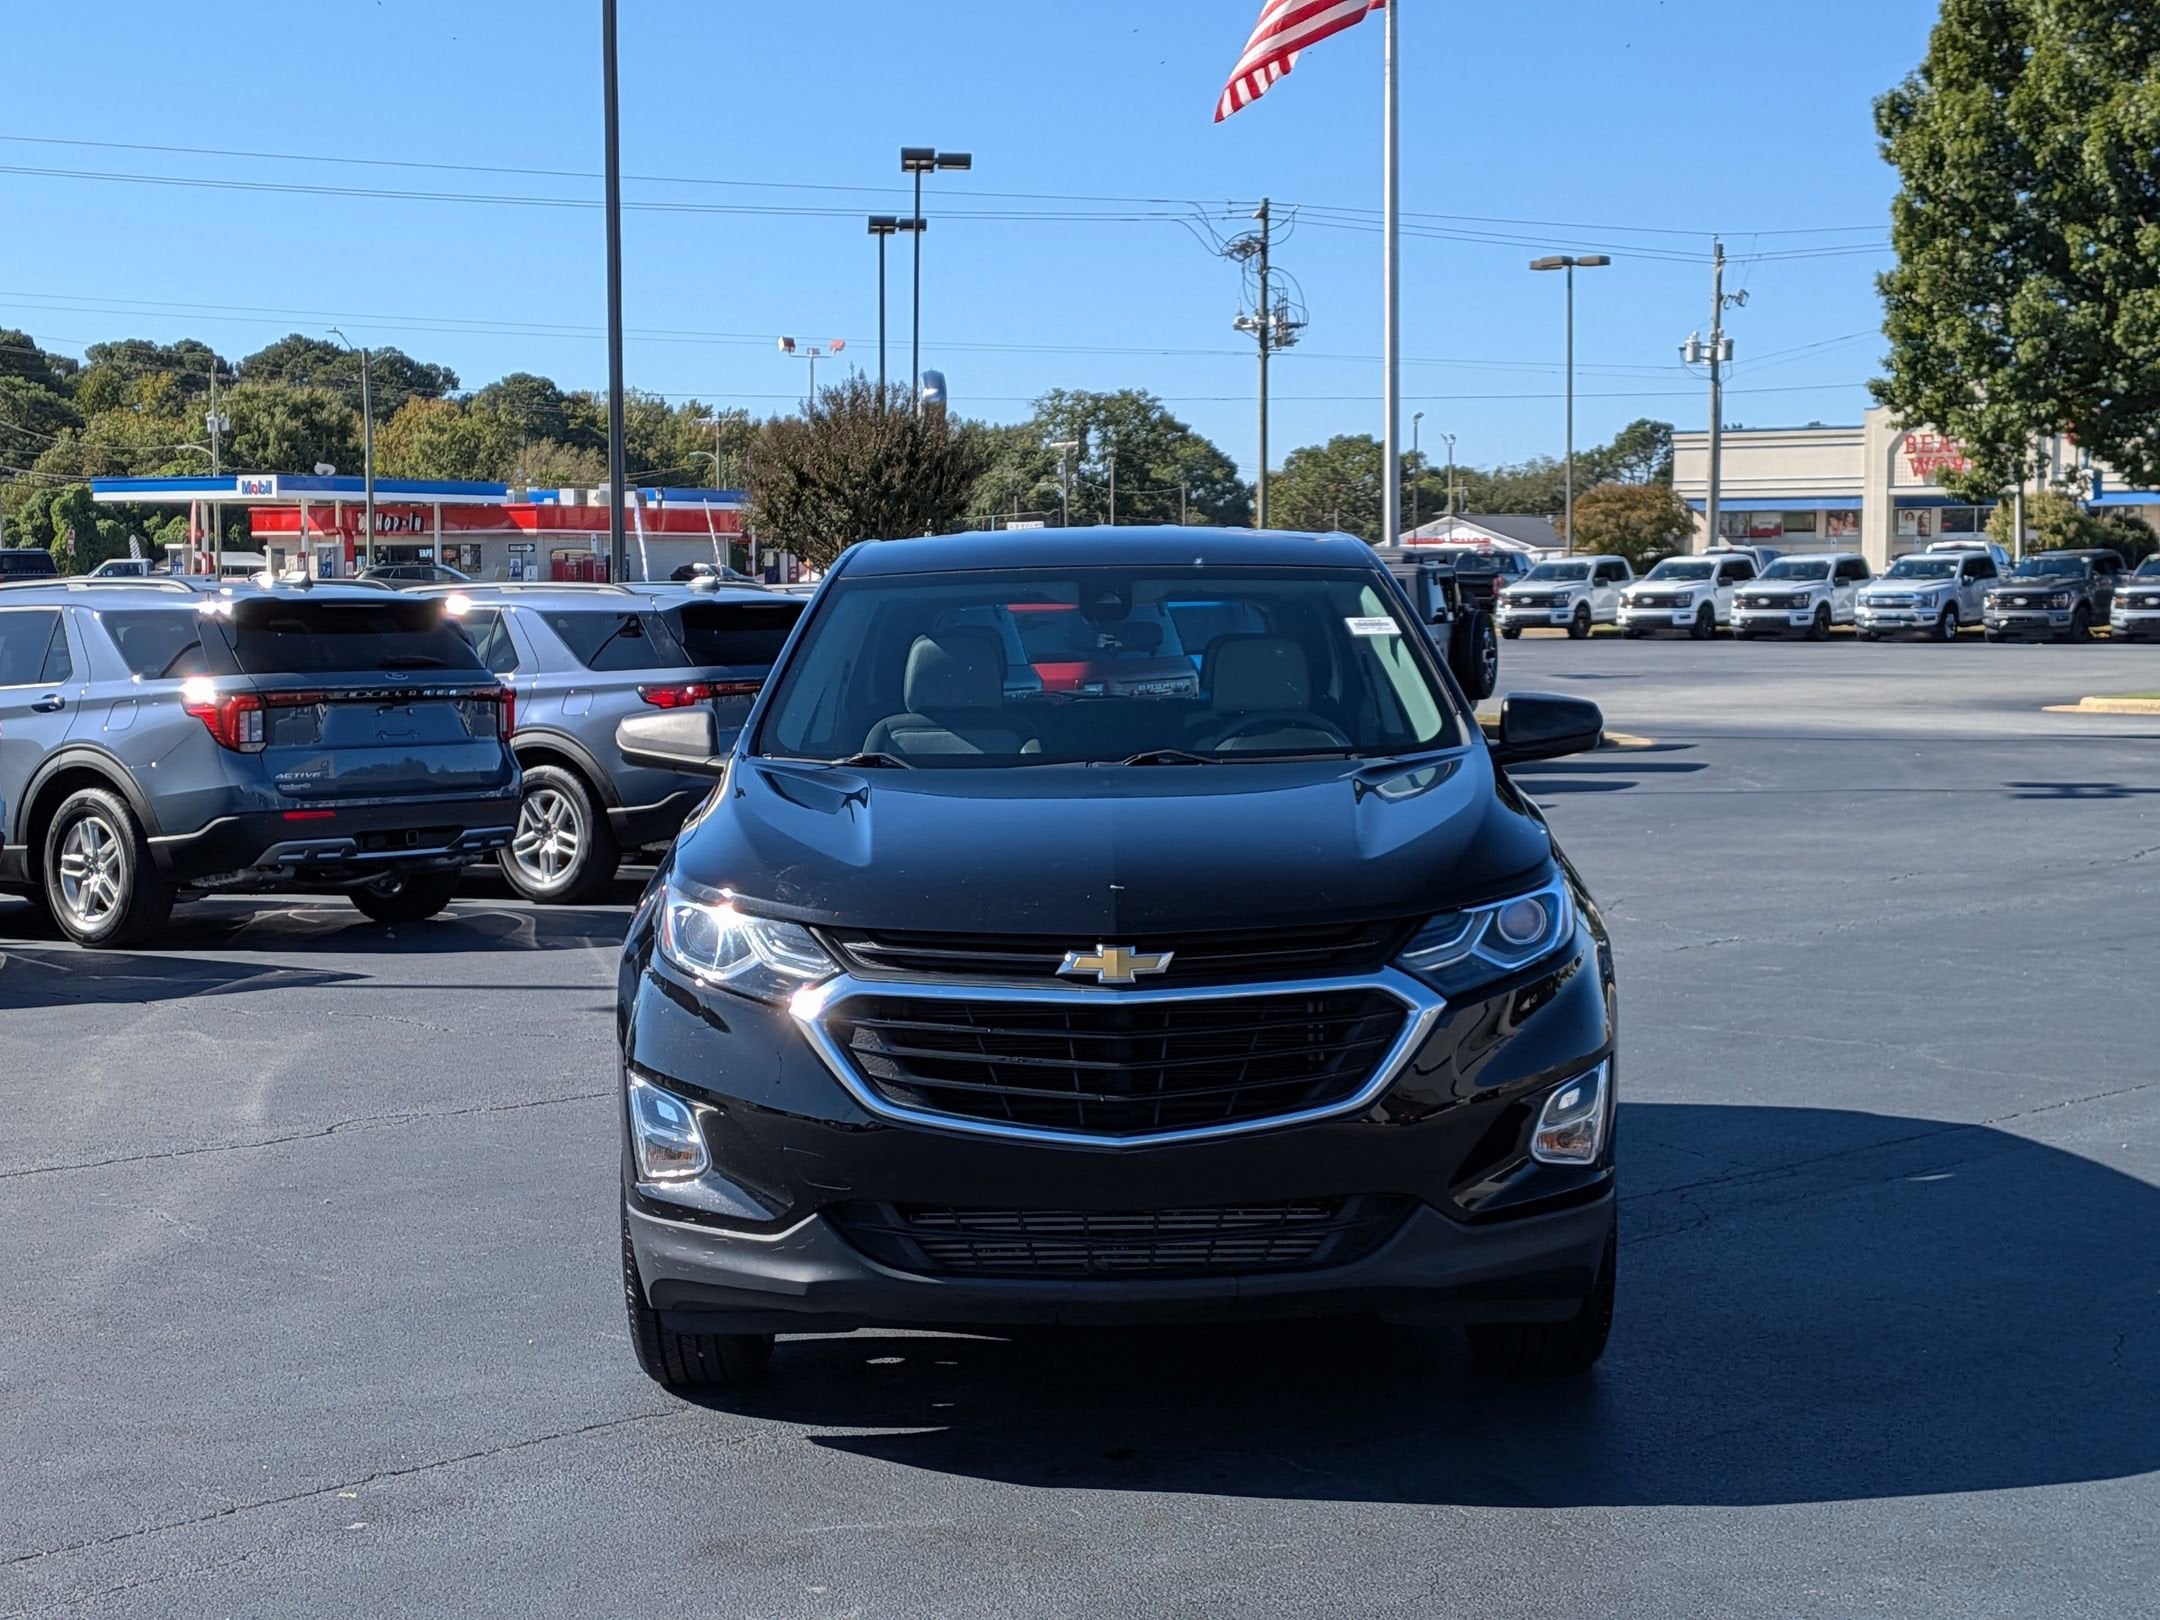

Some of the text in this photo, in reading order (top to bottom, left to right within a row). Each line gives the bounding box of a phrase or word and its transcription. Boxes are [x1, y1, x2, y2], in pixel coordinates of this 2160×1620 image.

[1904, 433, 1960, 454] BEA
[241, 480, 273, 496] Mobil
[348, 688, 458, 698] EXPLORER
